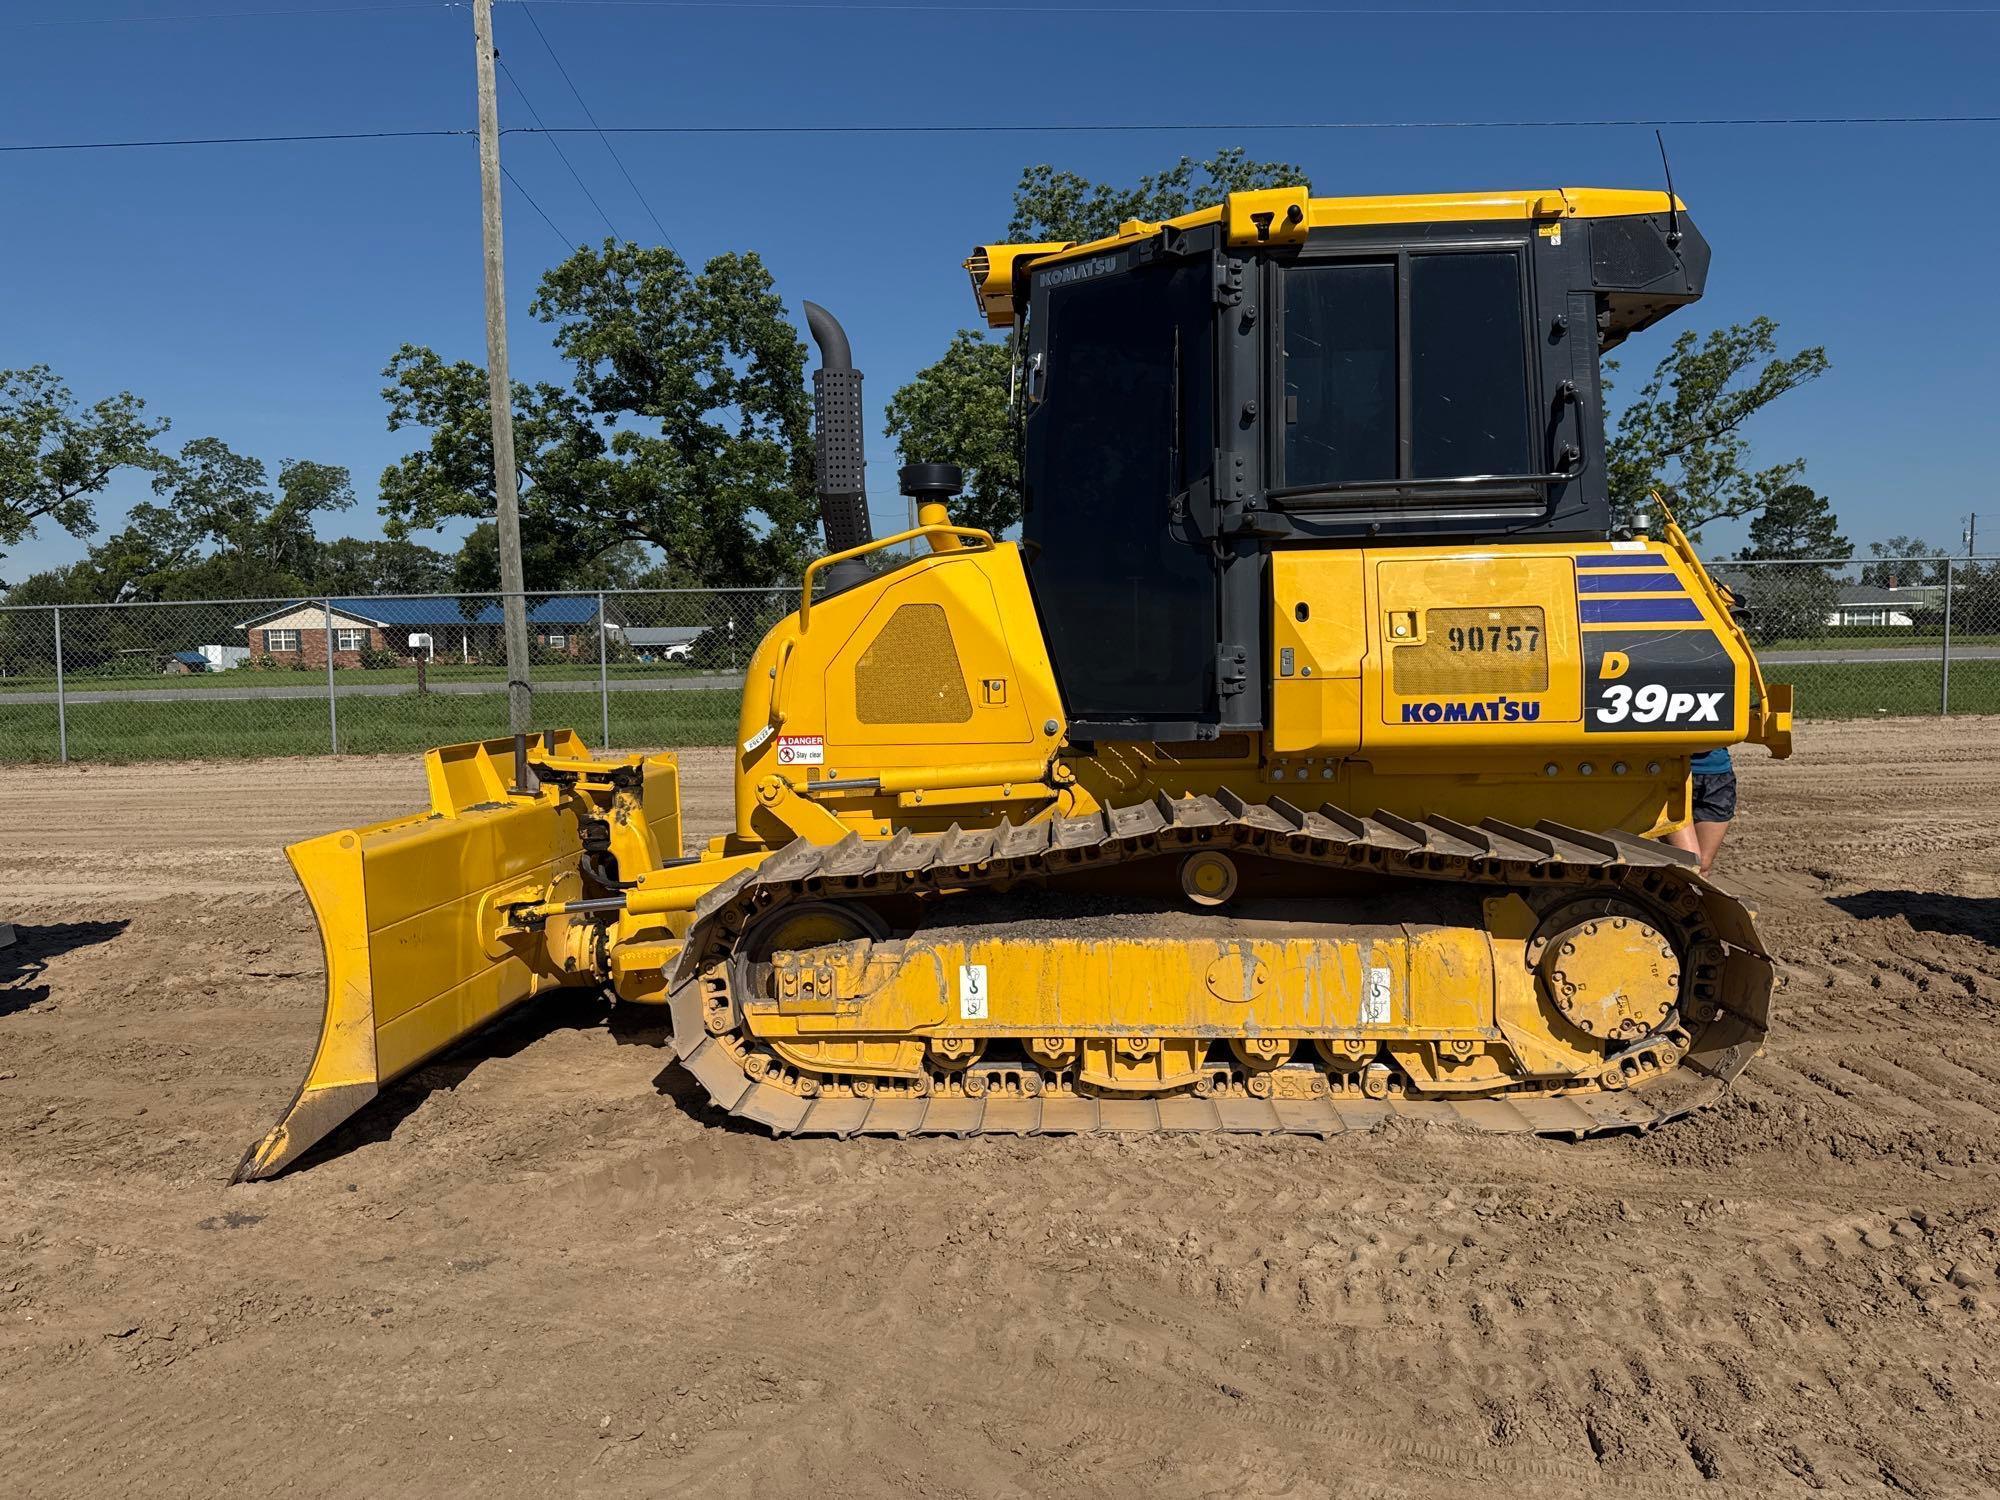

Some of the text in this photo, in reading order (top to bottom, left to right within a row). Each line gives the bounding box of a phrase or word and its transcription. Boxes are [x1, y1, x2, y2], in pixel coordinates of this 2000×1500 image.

[1039, 256, 1117, 288] KOMATSU
[1449, 626, 1540, 652] 90757
[1599, 651, 1630, 680] D
[1402, 696, 1540, 722] KOMATSU
[1596, 684, 1726, 724] 39PX
[788, 737, 823, 745] DANGER
[796, 751, 822, 760] Stay clear
